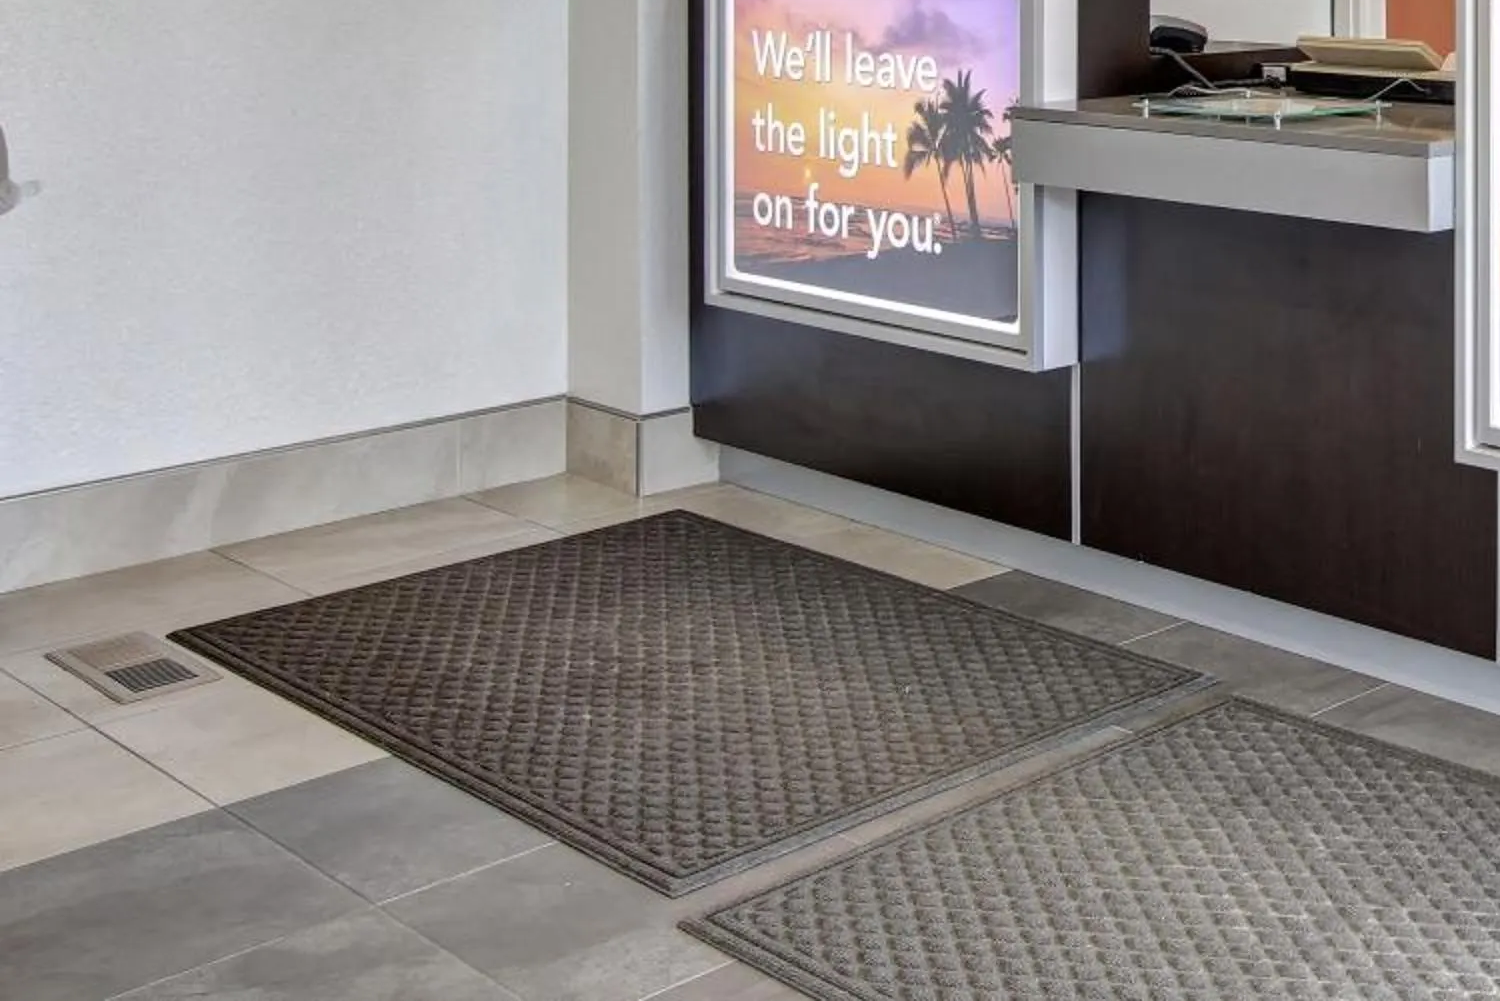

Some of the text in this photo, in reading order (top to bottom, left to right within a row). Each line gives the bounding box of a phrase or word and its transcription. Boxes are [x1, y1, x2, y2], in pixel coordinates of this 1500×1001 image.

[751, 30, 938, 91] We'll leave
[751, 103, 898, 177] the light
[752, 191, 793, 230] on
[804, 182, 854, 238] for
